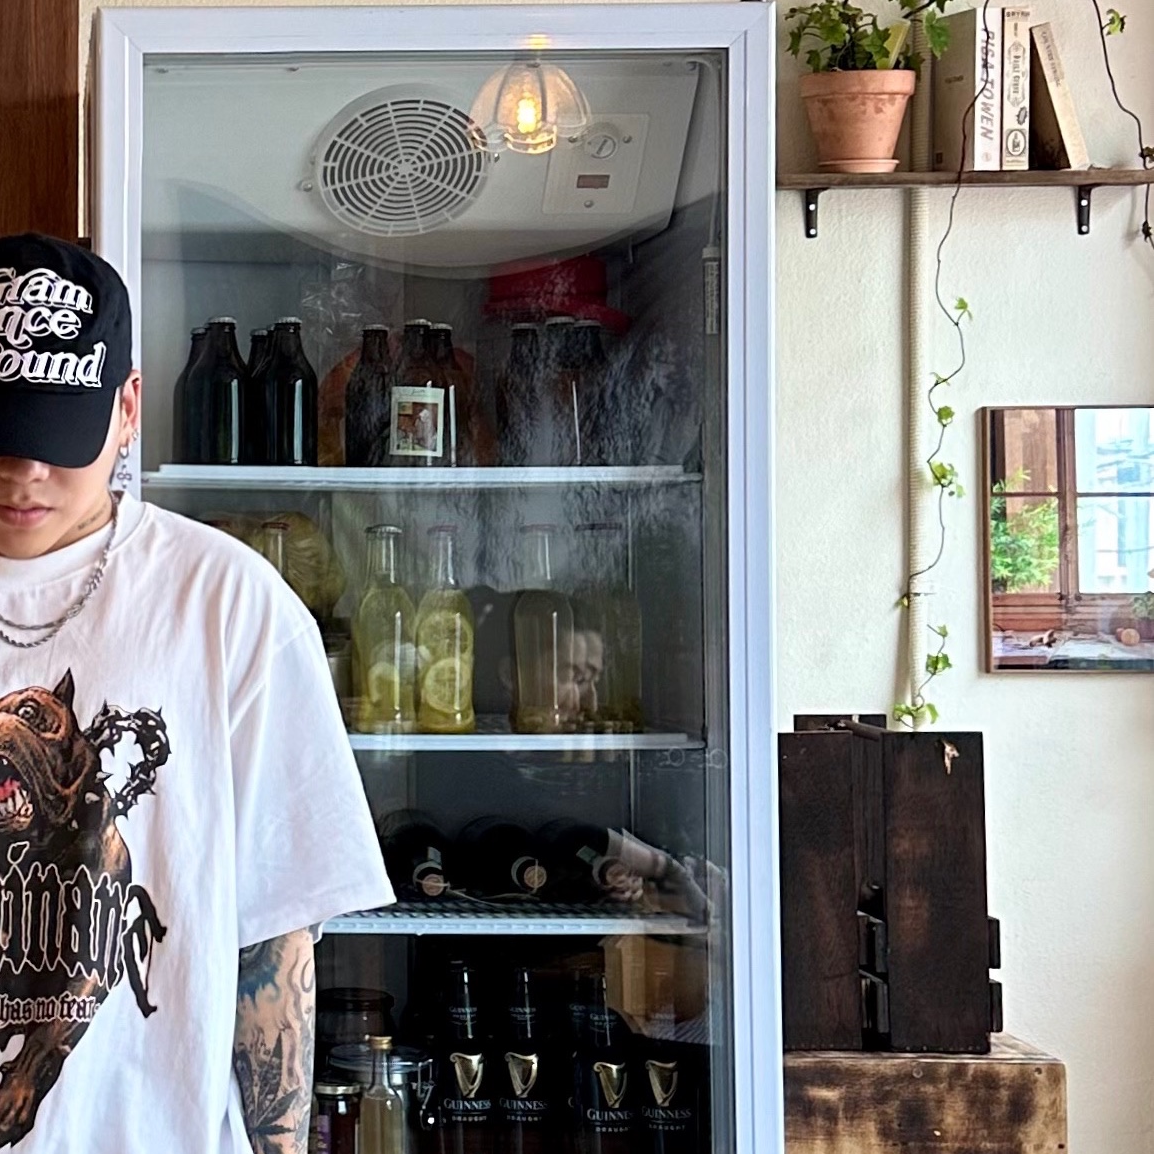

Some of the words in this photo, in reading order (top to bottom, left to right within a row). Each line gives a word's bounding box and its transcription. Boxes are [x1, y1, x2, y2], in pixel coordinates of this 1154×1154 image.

[35, 997, 56, 1021] no
[443, 1097, 492, 1111] GUINNESS
[642, 1105, 692, 1119] GUINNESS
